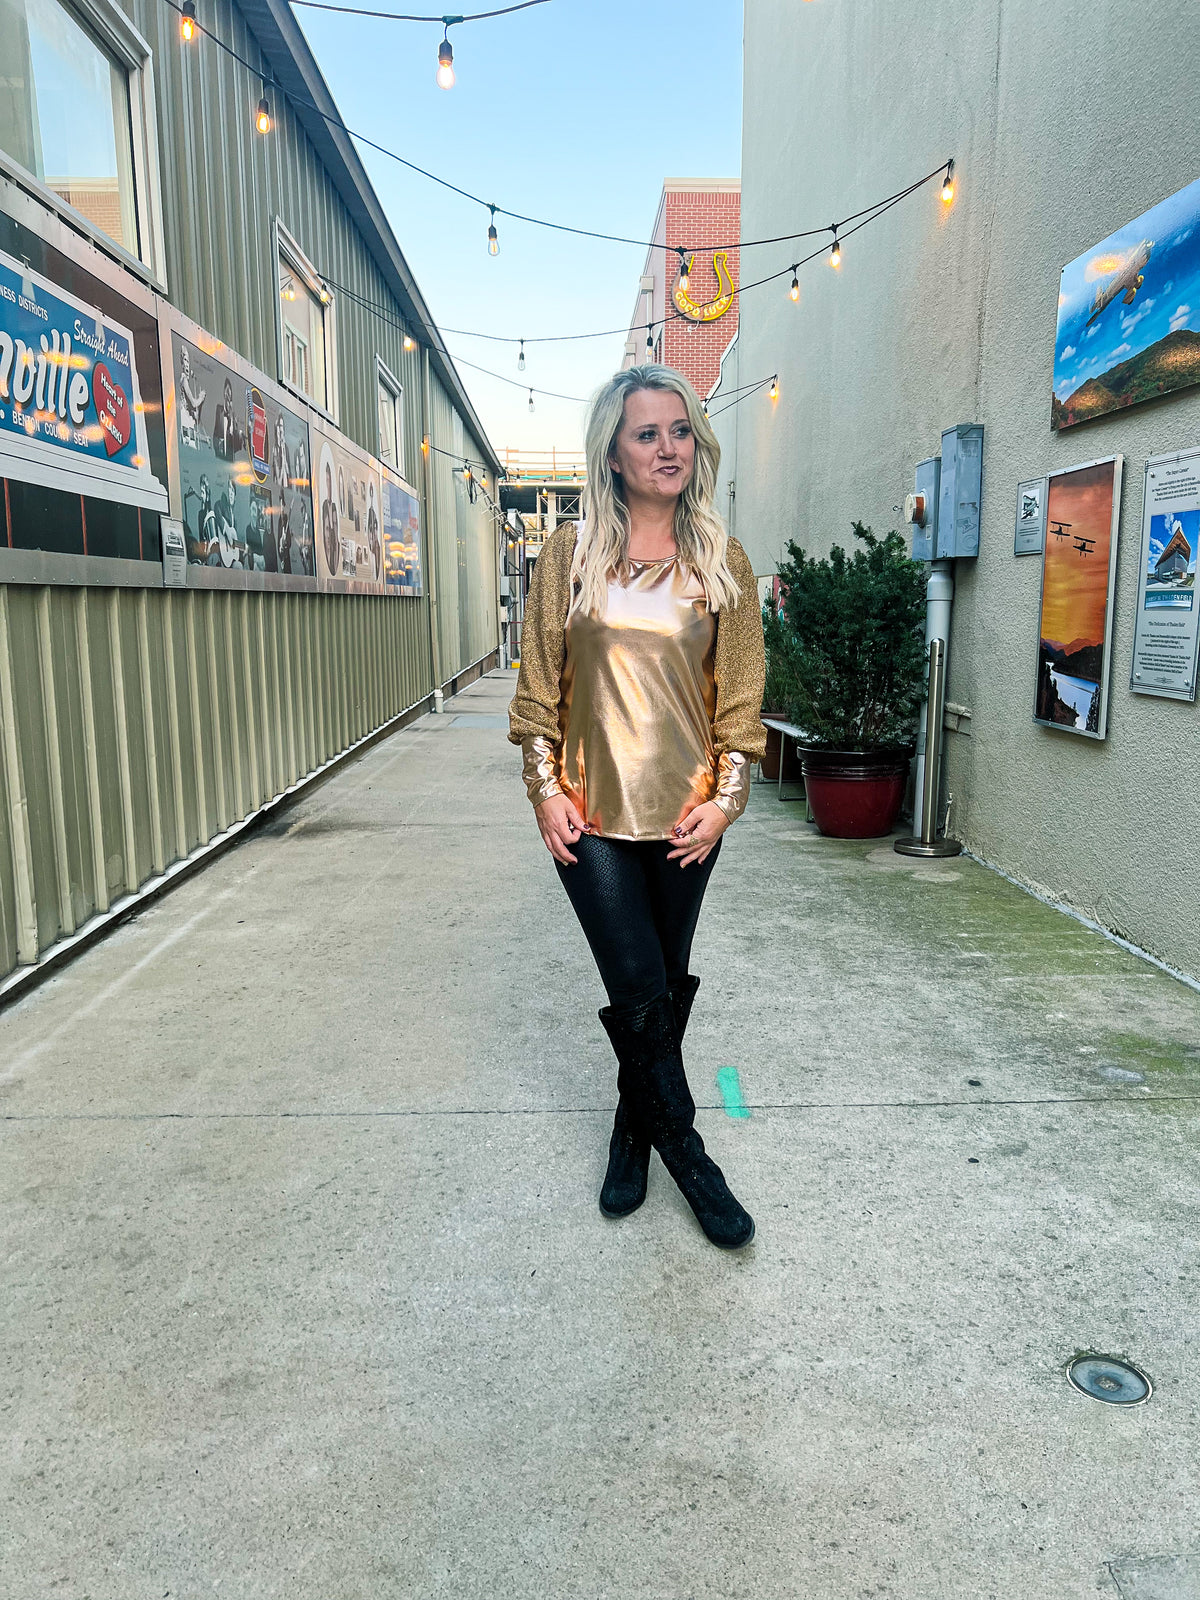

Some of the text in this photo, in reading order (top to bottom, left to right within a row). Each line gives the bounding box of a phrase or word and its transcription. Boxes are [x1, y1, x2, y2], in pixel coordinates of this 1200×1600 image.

[18, 294, 49, 321] DISTRICTS
[704, 295, 729, 317] LUCK
[74, 319, 105, 357] Straight
[101, 373, 123, 408] Heart of
[106, 398, 117, 417] the
[44, 422, 69, 441] COU
[73, 432, 89, 448] SEAT
[100, 410, 123, 444] OZARKS
